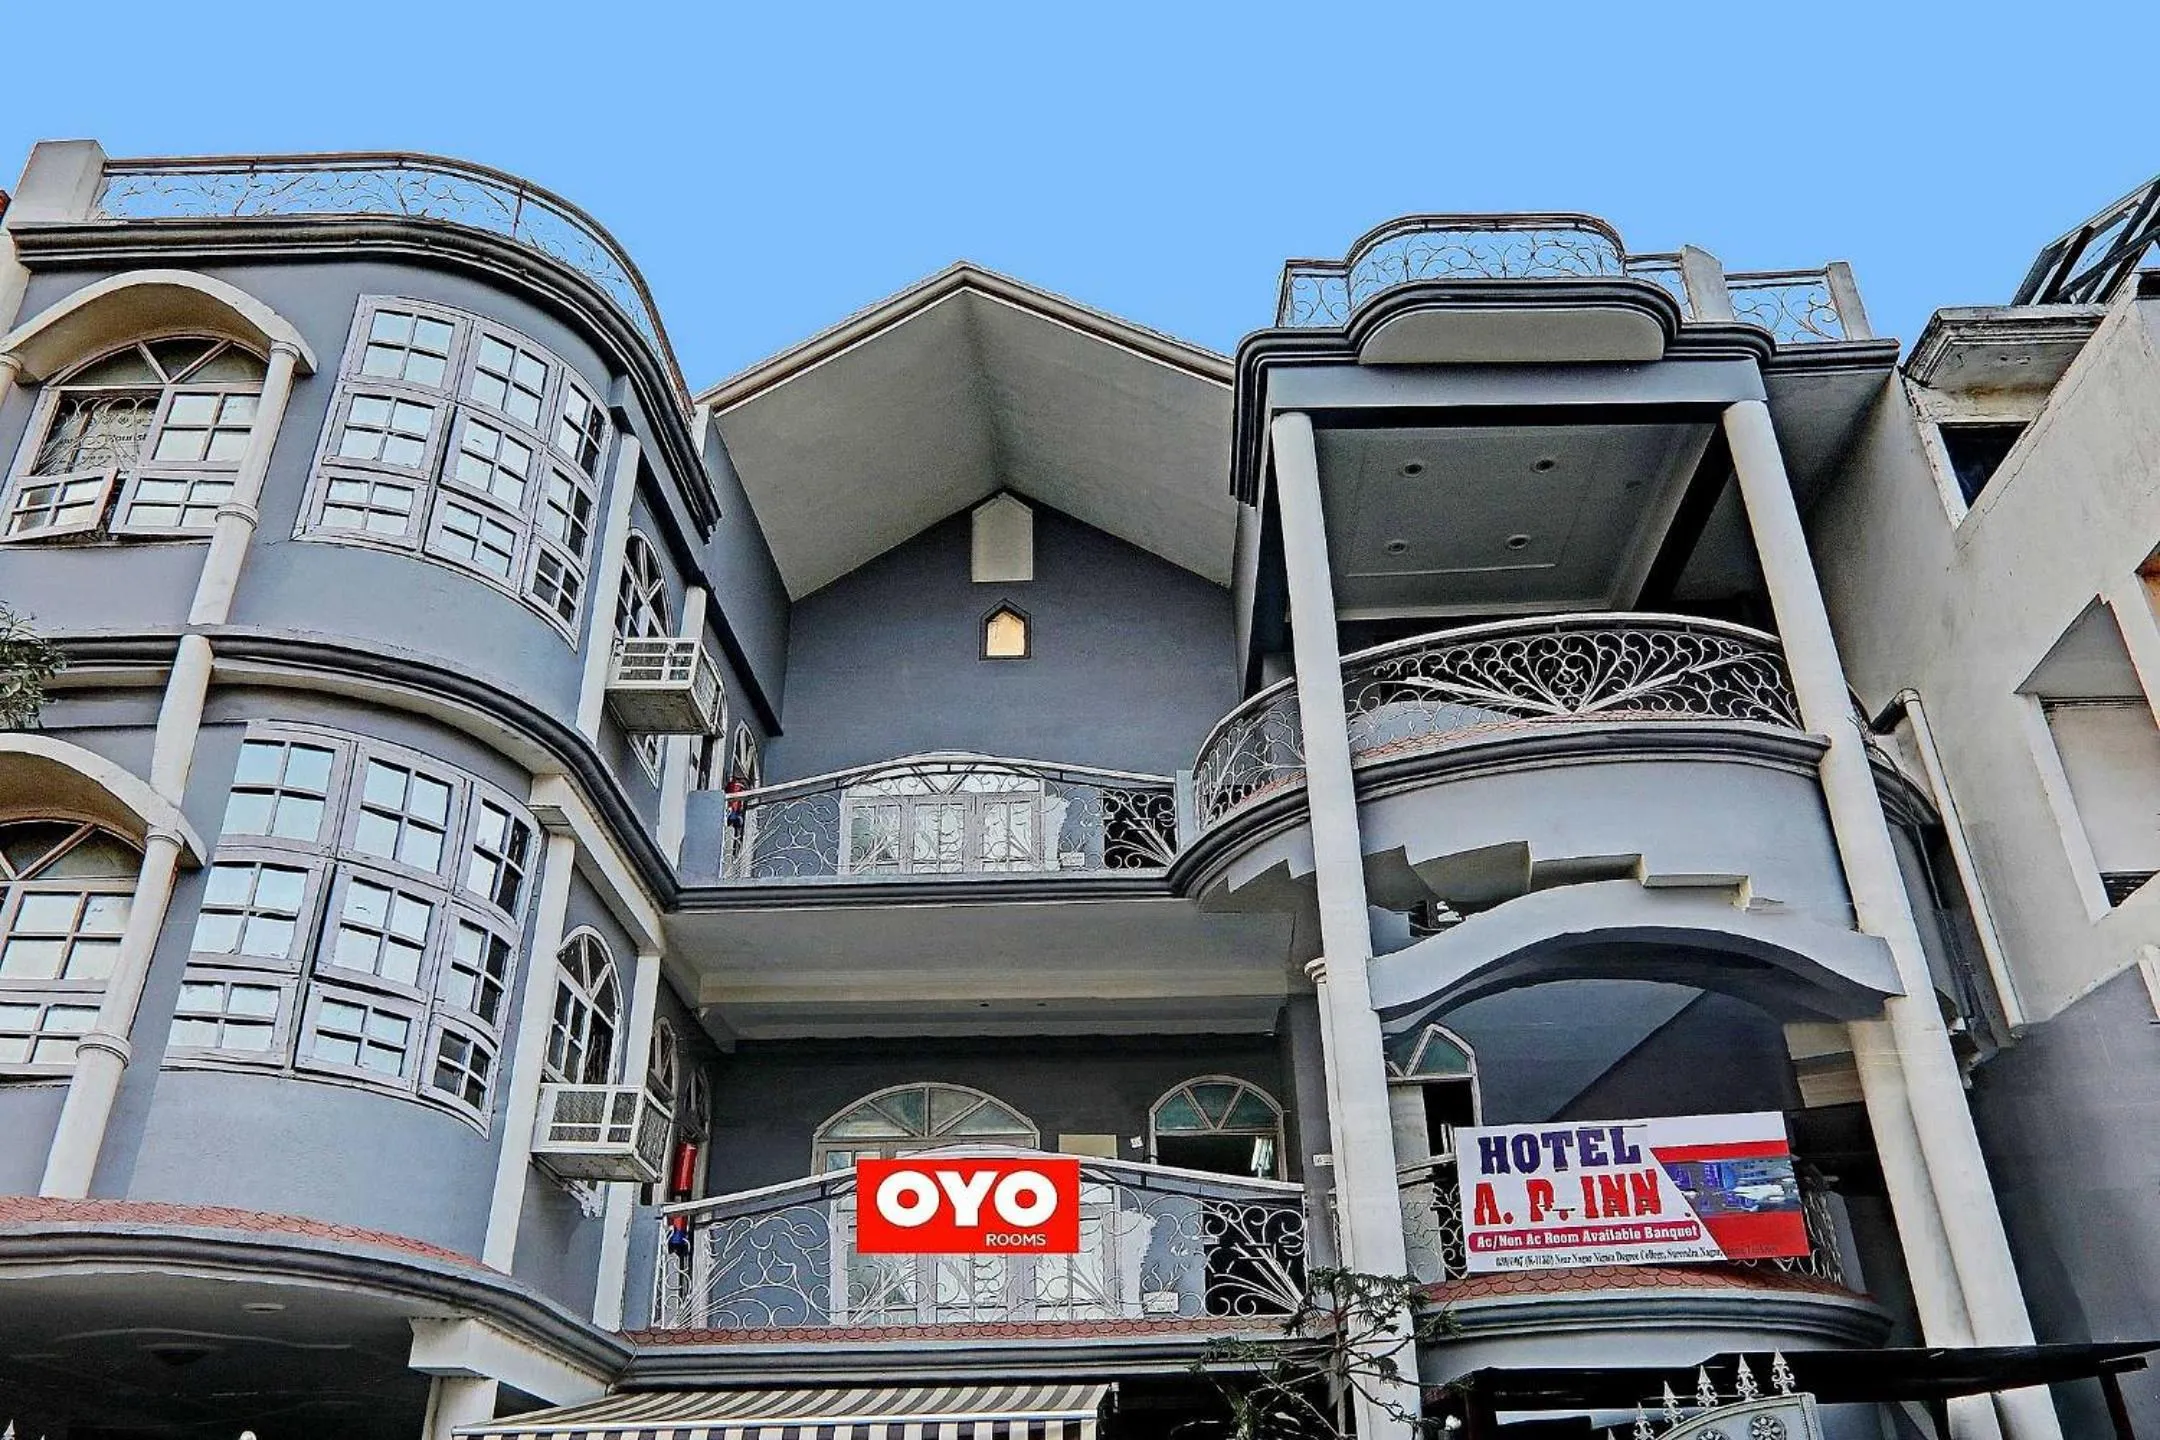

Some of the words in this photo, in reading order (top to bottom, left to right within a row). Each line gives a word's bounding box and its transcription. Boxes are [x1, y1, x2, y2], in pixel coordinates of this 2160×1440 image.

[1478, 1126, 1642, 1174] HOTEL
[876, 1170, 1058, 1228] OYO
[1580, 1169, 1661, 1218] INN
[985, 1233, 1046, 1246] ROOMS
[1527, 1234, 1541, 1246] Ac
[1545, 1232, 1579, 1245] Room
[1583, 1227, 1641, 1243] Available
[1644, 1223, 1699, 1240] Banquet
